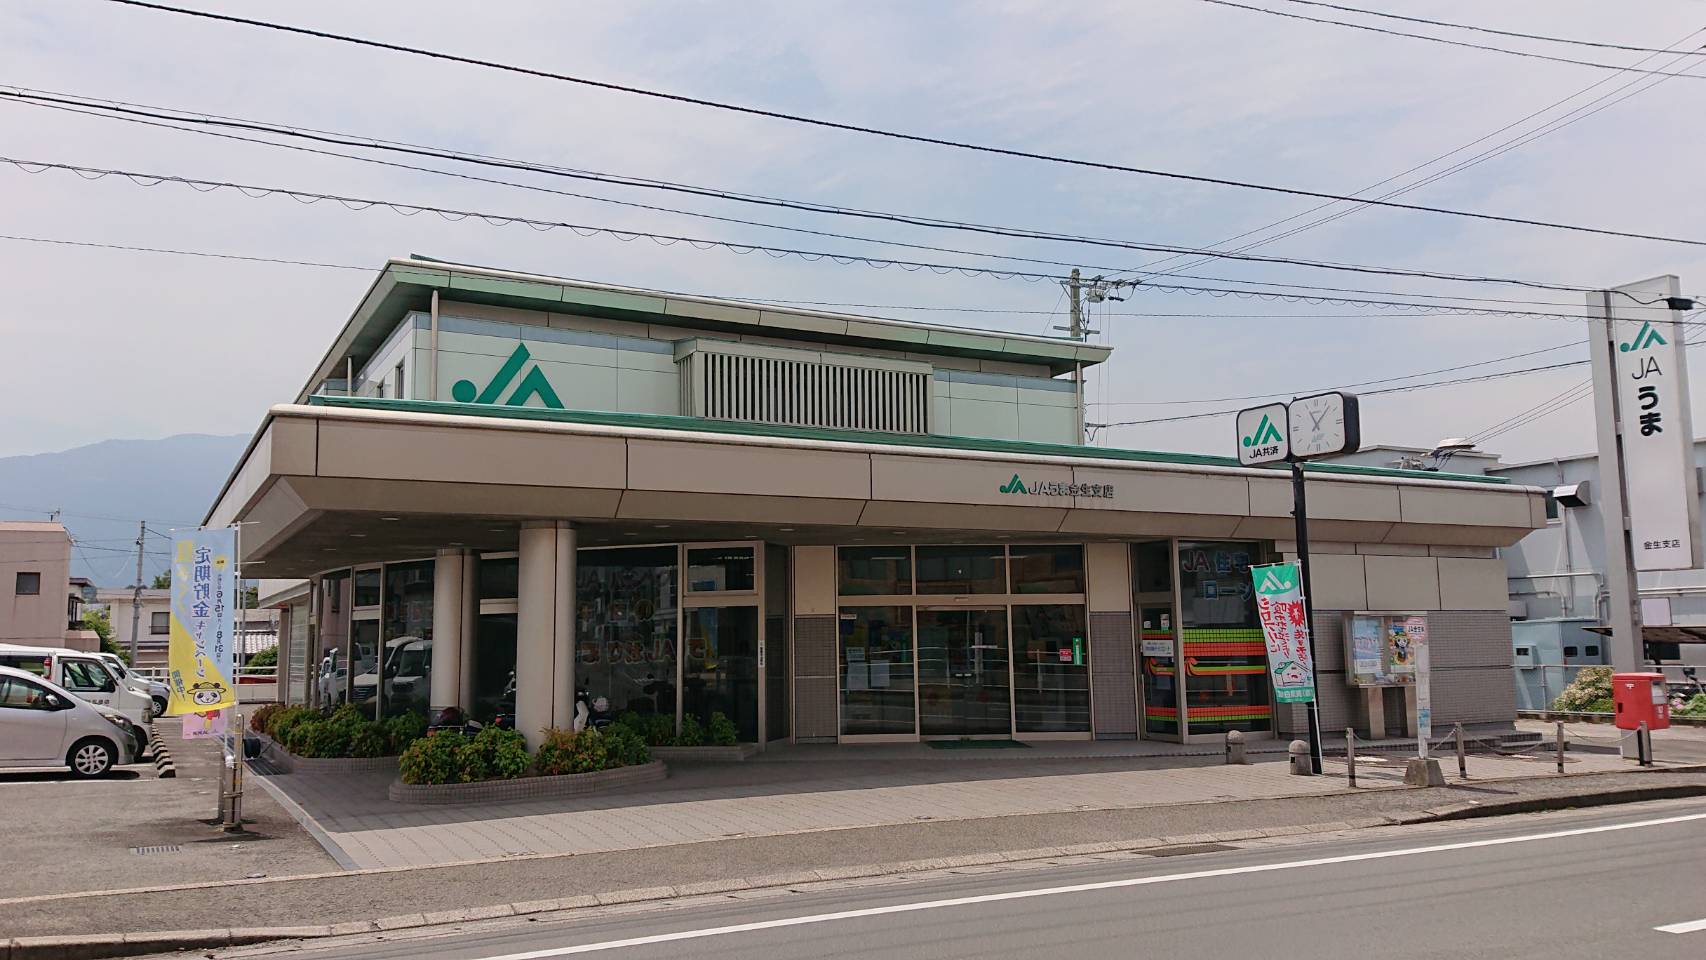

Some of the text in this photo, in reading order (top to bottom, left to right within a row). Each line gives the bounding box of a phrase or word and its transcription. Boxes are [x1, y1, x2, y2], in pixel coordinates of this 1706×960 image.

[1632, 356, 1662, 380] JA
[1638, 386, 1664, 437] うま
[1249, 445, 1279, 459] JA共済
[1643, 539, 1680, 550] 金生支店
